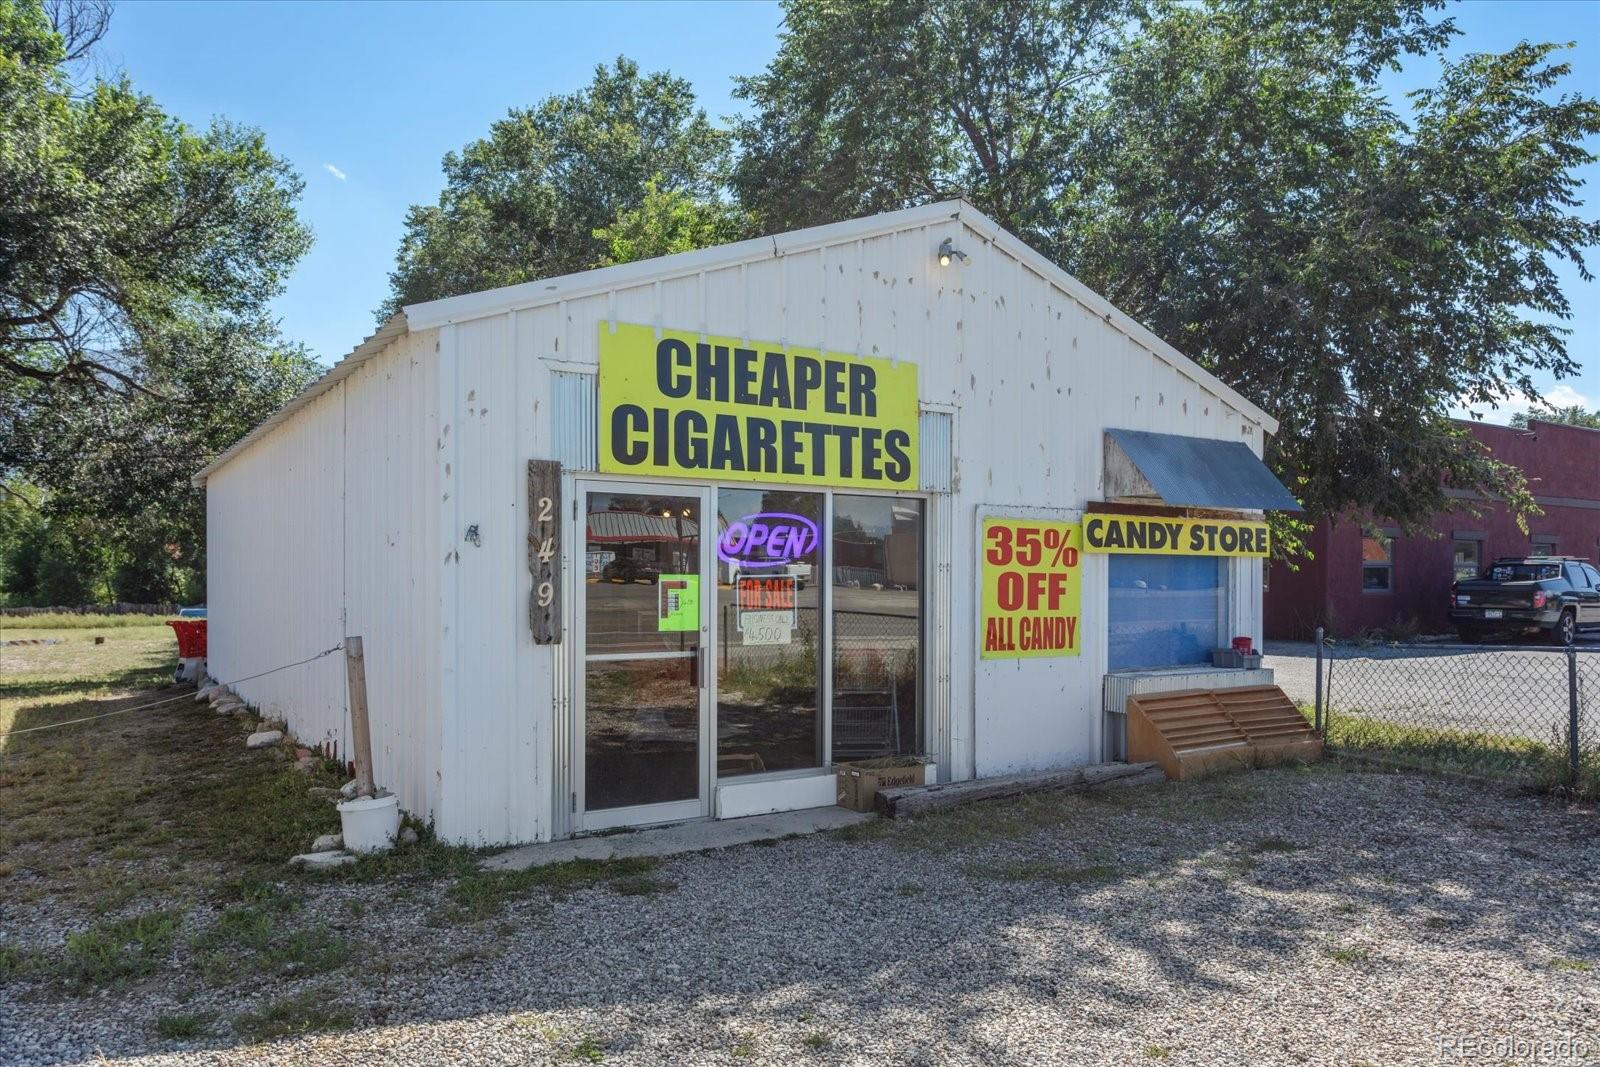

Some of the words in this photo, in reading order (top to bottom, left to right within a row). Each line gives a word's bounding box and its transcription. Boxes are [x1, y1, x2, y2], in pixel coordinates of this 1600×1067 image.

[656, 338, 877, 417] CHEAPER
[611, 404, 911, 482] CIGARETTES
[537, 497, 555, 607] 249
[723, 522, 809, 558] OPEN
[986, 525, 1078, 568] 35%
[1086, 519, 1184, 550] CANDY
[1189, 524, 1267, 553] STORE
[740, 579, 761, 609] FOR
[765, 579, 794, 609] SALE
[997, 571, 1068, 611] OFF
[985, 617, 1015, 651] ALL
[1019, 616, 1077, 651] CANDY
